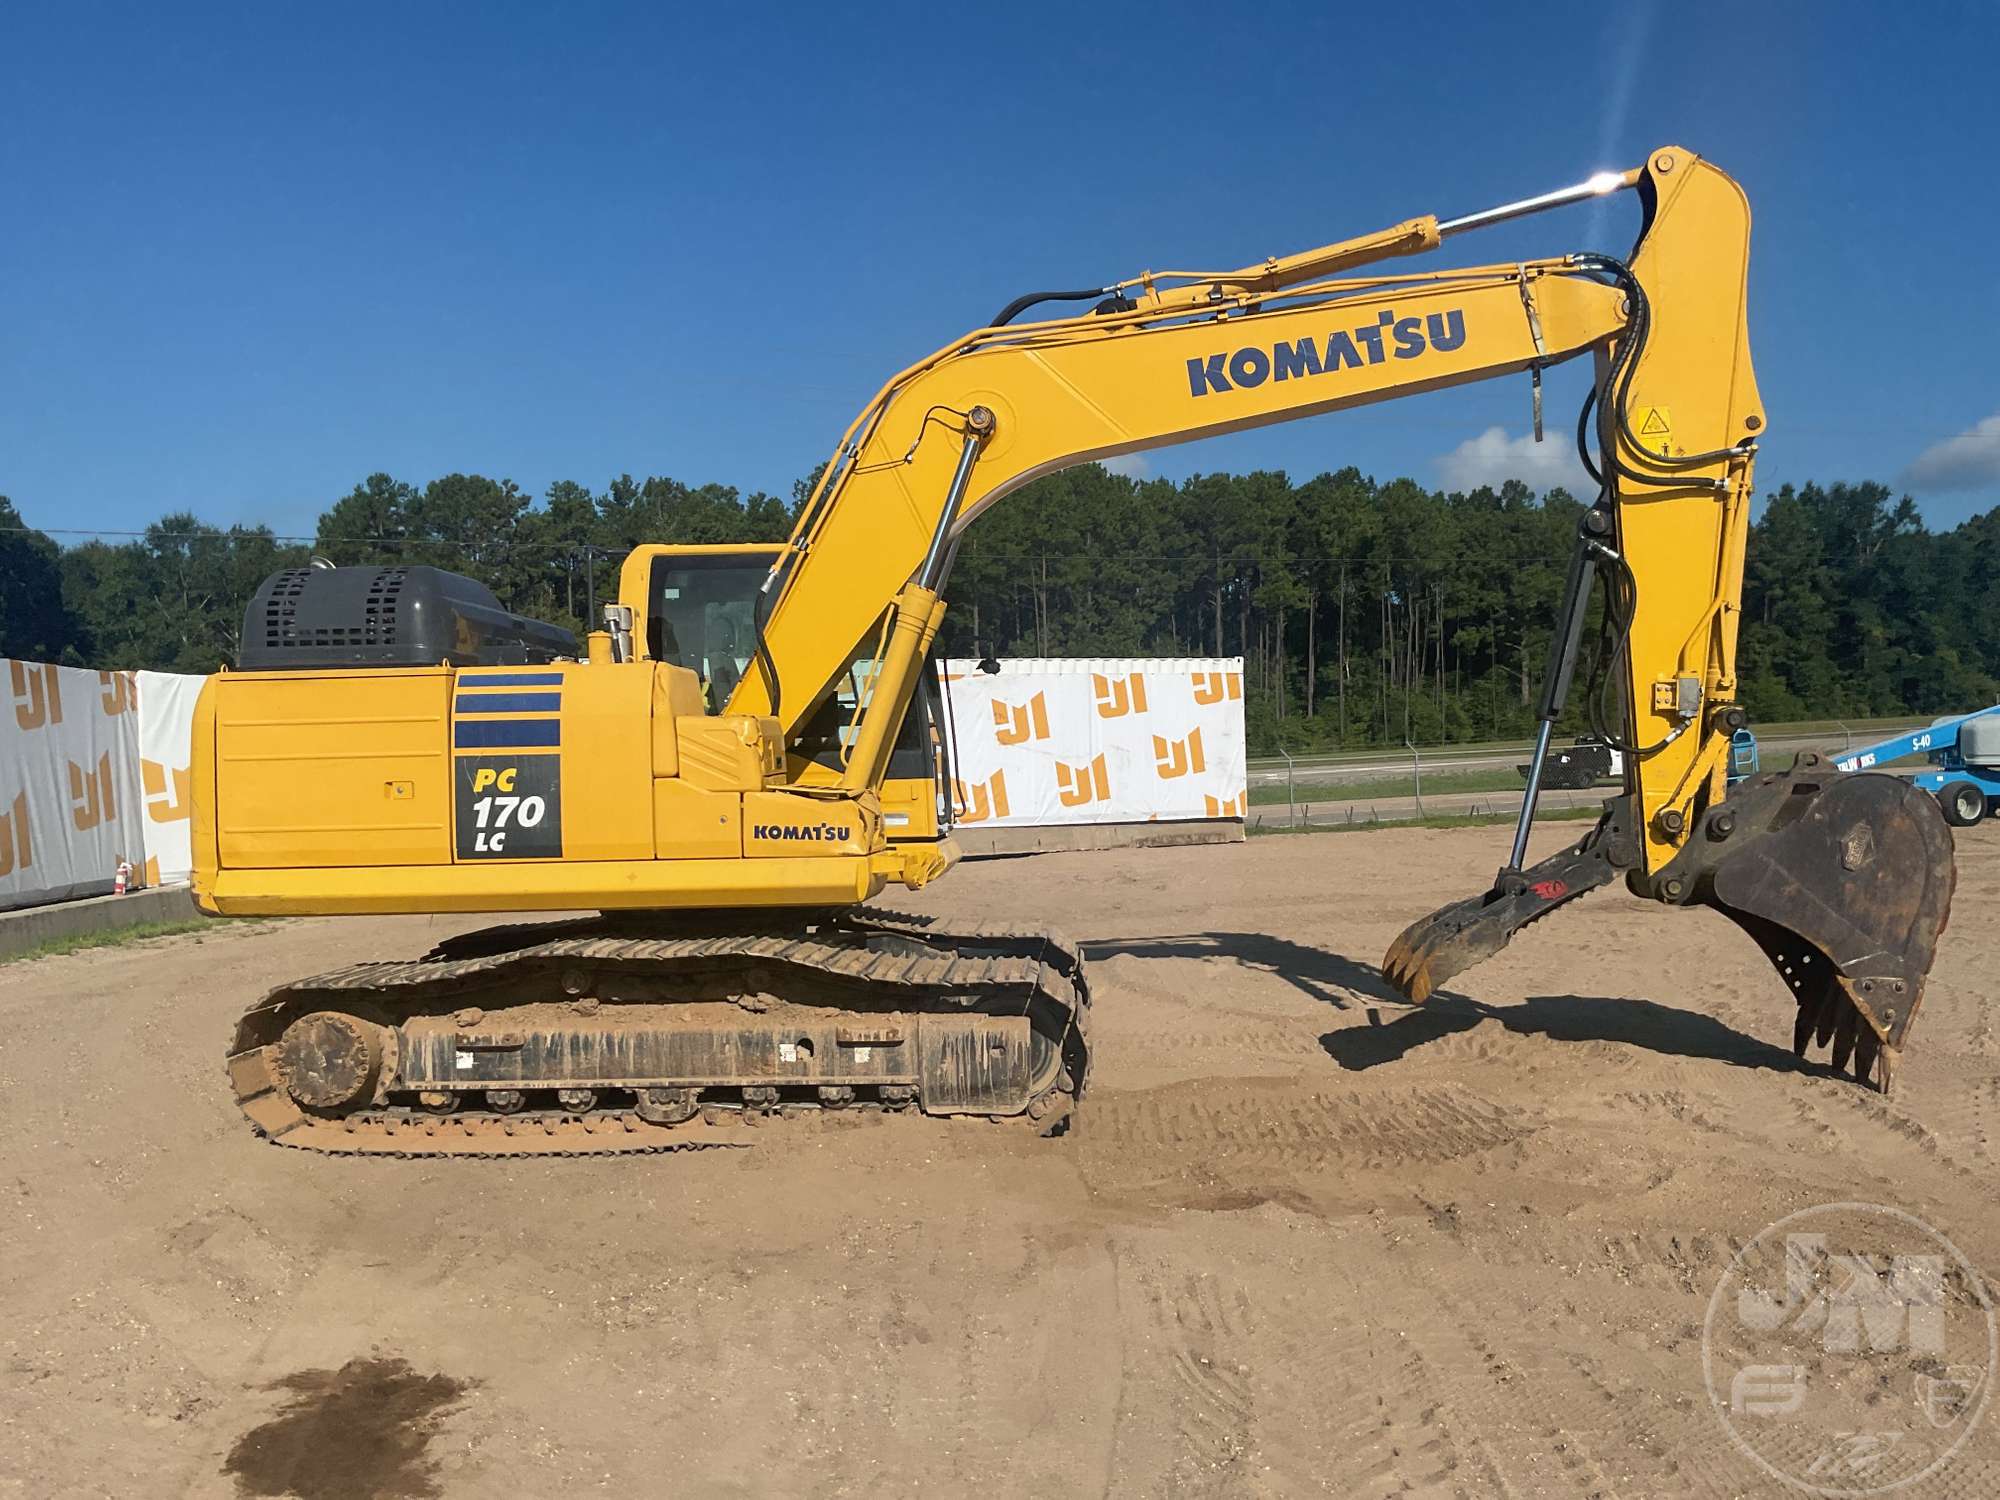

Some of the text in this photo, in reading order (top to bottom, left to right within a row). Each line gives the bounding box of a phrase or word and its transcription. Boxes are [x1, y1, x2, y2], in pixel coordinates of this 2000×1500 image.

[1186, 309, 1467, 397] KOMATSU
[1912, 734, 1931, 751] S-40
[473, 767, 518, 793] PC
[473, 795, 546, 828] 170
[474, 832, 506, 852] LC
[753, 822, 851, 841] KOMATSU
